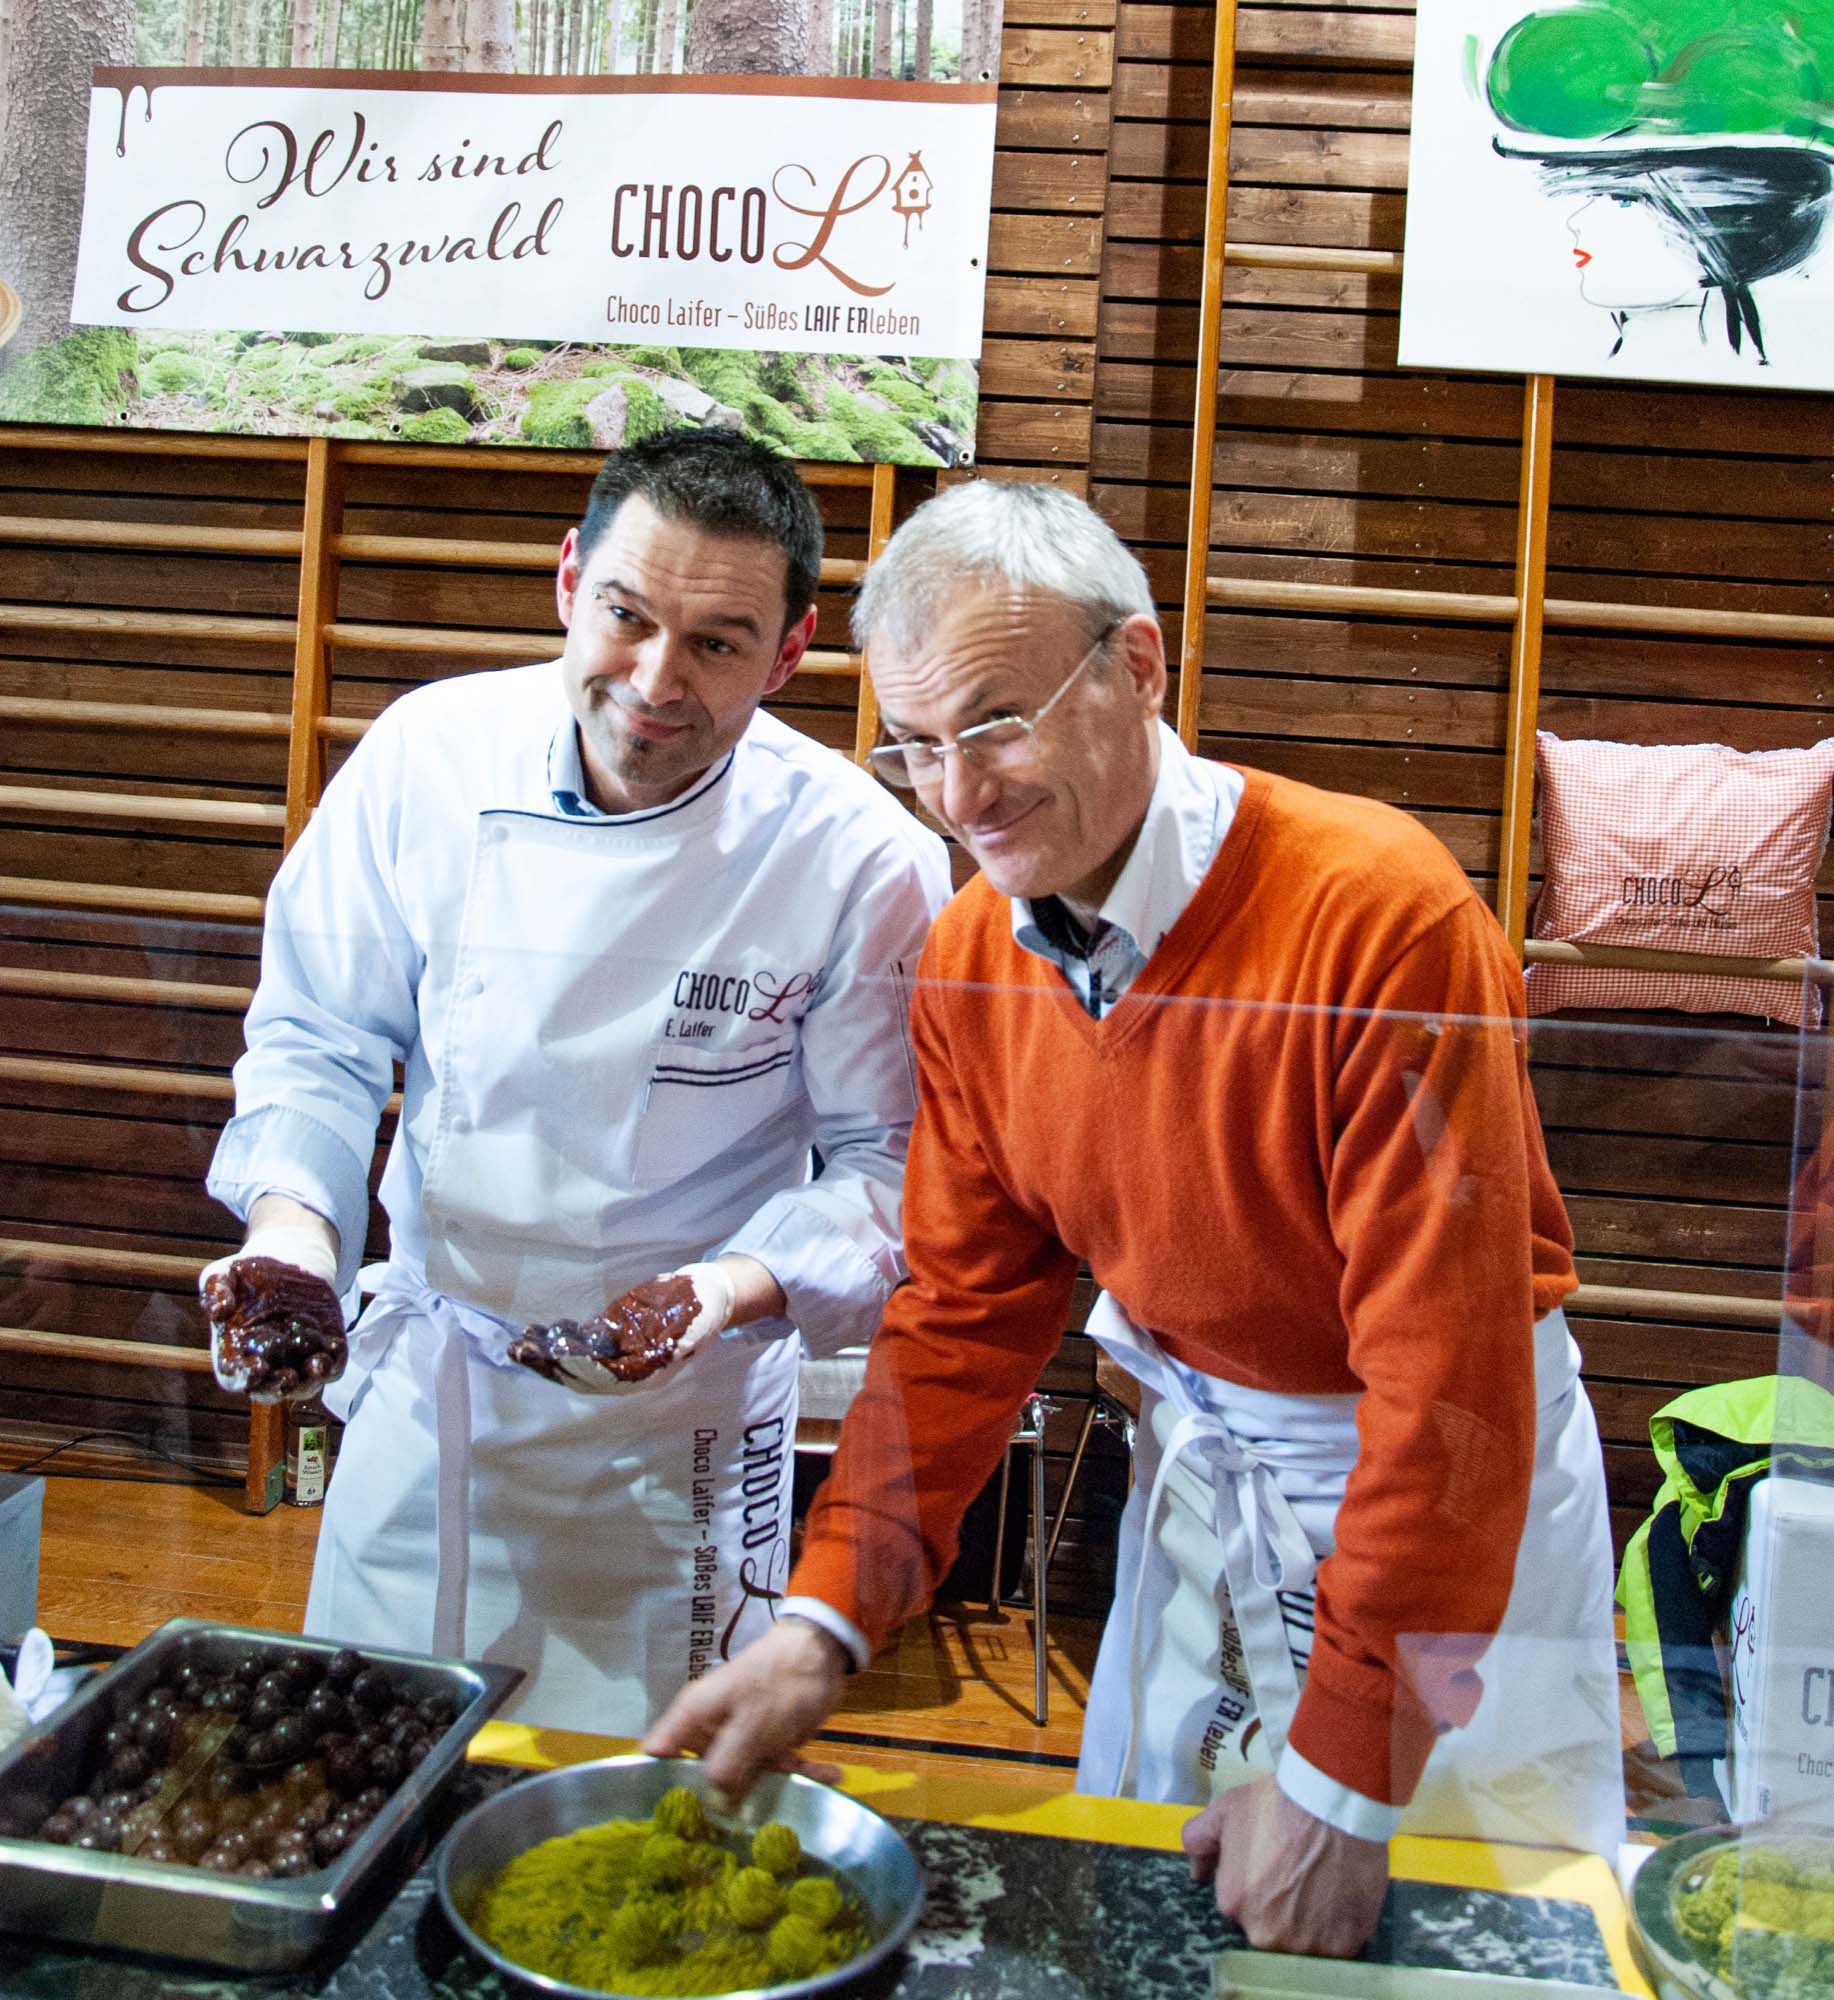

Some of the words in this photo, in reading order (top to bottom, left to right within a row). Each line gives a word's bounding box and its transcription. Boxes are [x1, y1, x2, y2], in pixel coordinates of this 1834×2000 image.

[225, 111, 399, 210] Wir
[417, 119, 563, 183] sind
[117, 198, 563, 313] Schwarzwald
[606, 295, 661, 326] Choco
[667, 298, 722, 328] Laifer
[744, 301, 798, 331] Süßes
[804, 304, 841, 333] LAIF
[847, 305, 920, 336] ERleben
[665, 1018, 676, 1038] E.
[680, 1017, 716, 1038] Laifer
[694, 1428, 718, 1473] Choco
[692, 1480, 716, 1526] Laifer
[692, 1595, 716, 1625] LAIF
[688, 1629, 714, 1682] ERlebe
